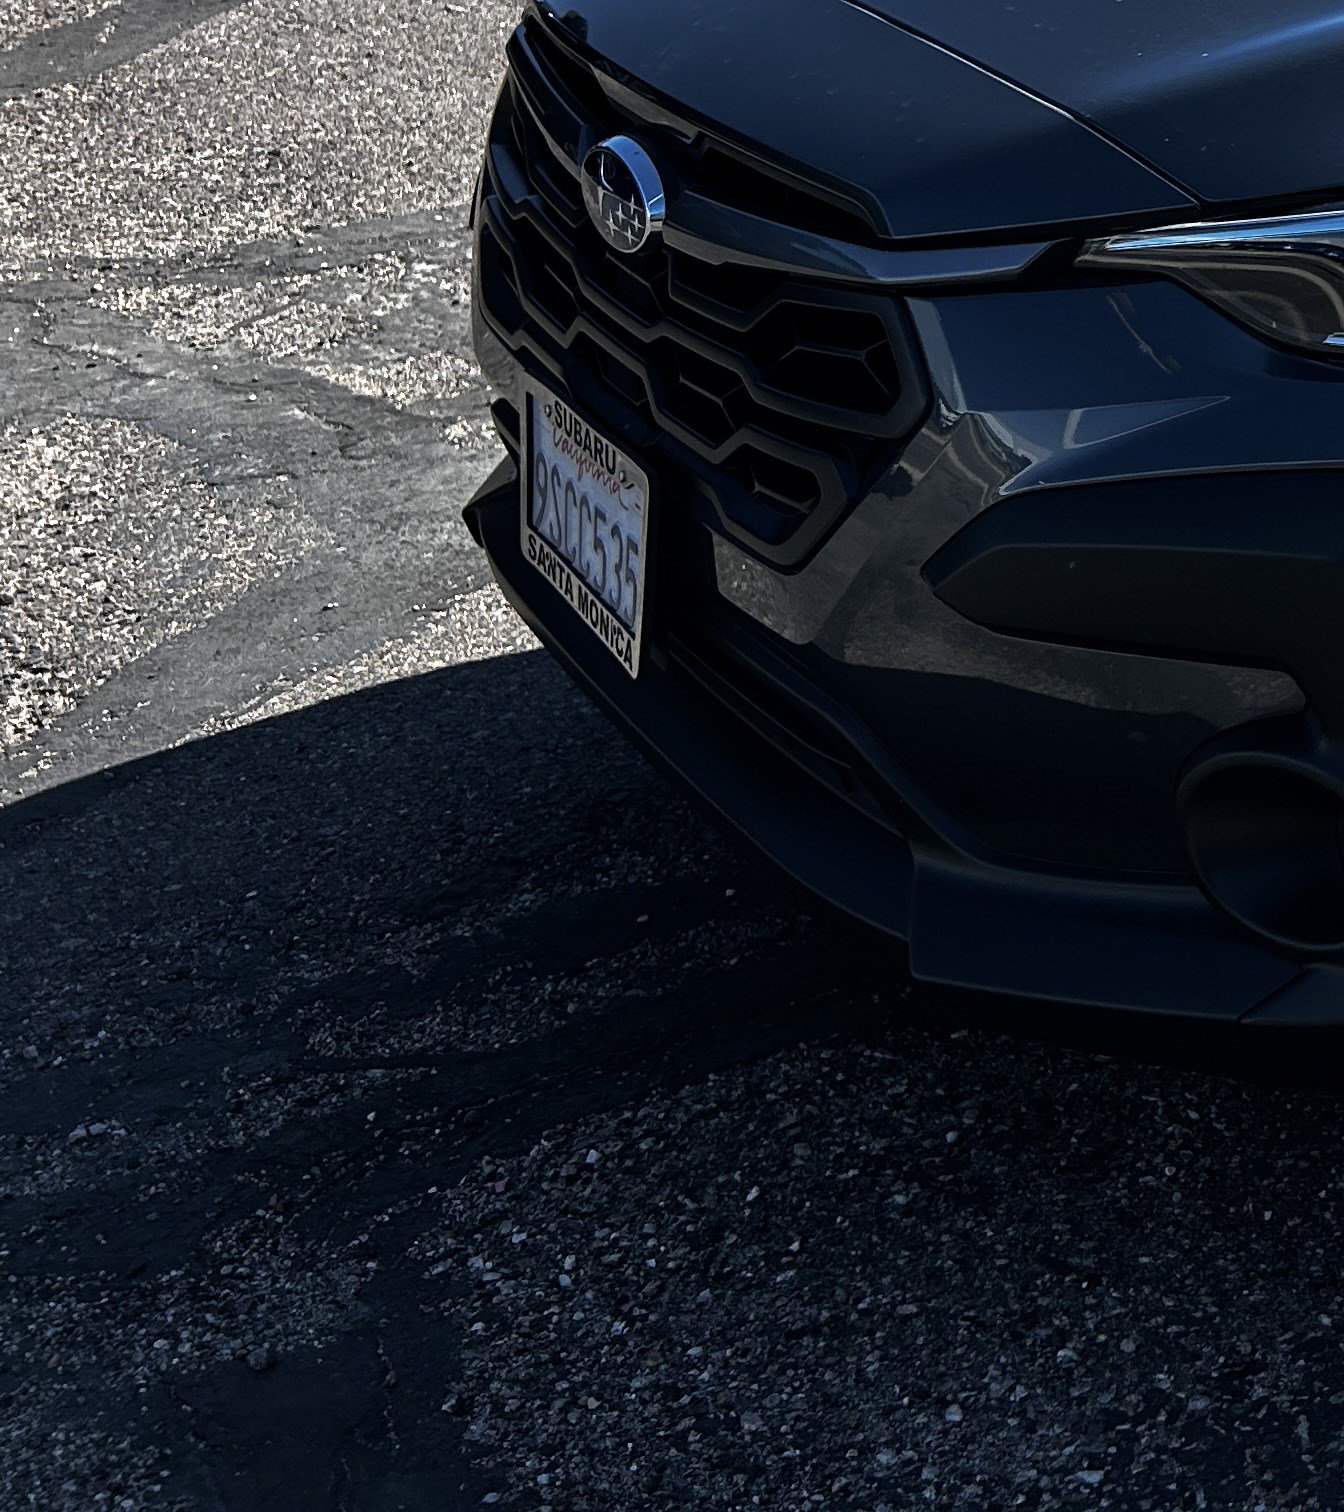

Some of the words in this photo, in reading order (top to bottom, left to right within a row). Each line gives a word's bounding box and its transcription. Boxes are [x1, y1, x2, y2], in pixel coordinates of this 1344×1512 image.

[553, 399, 618, 476] SUBARU
[528, 532, 575, 604] SANTA
[577, 590, 634, 672] MONICA
[534, 451, 639, 630] 9SCC535
